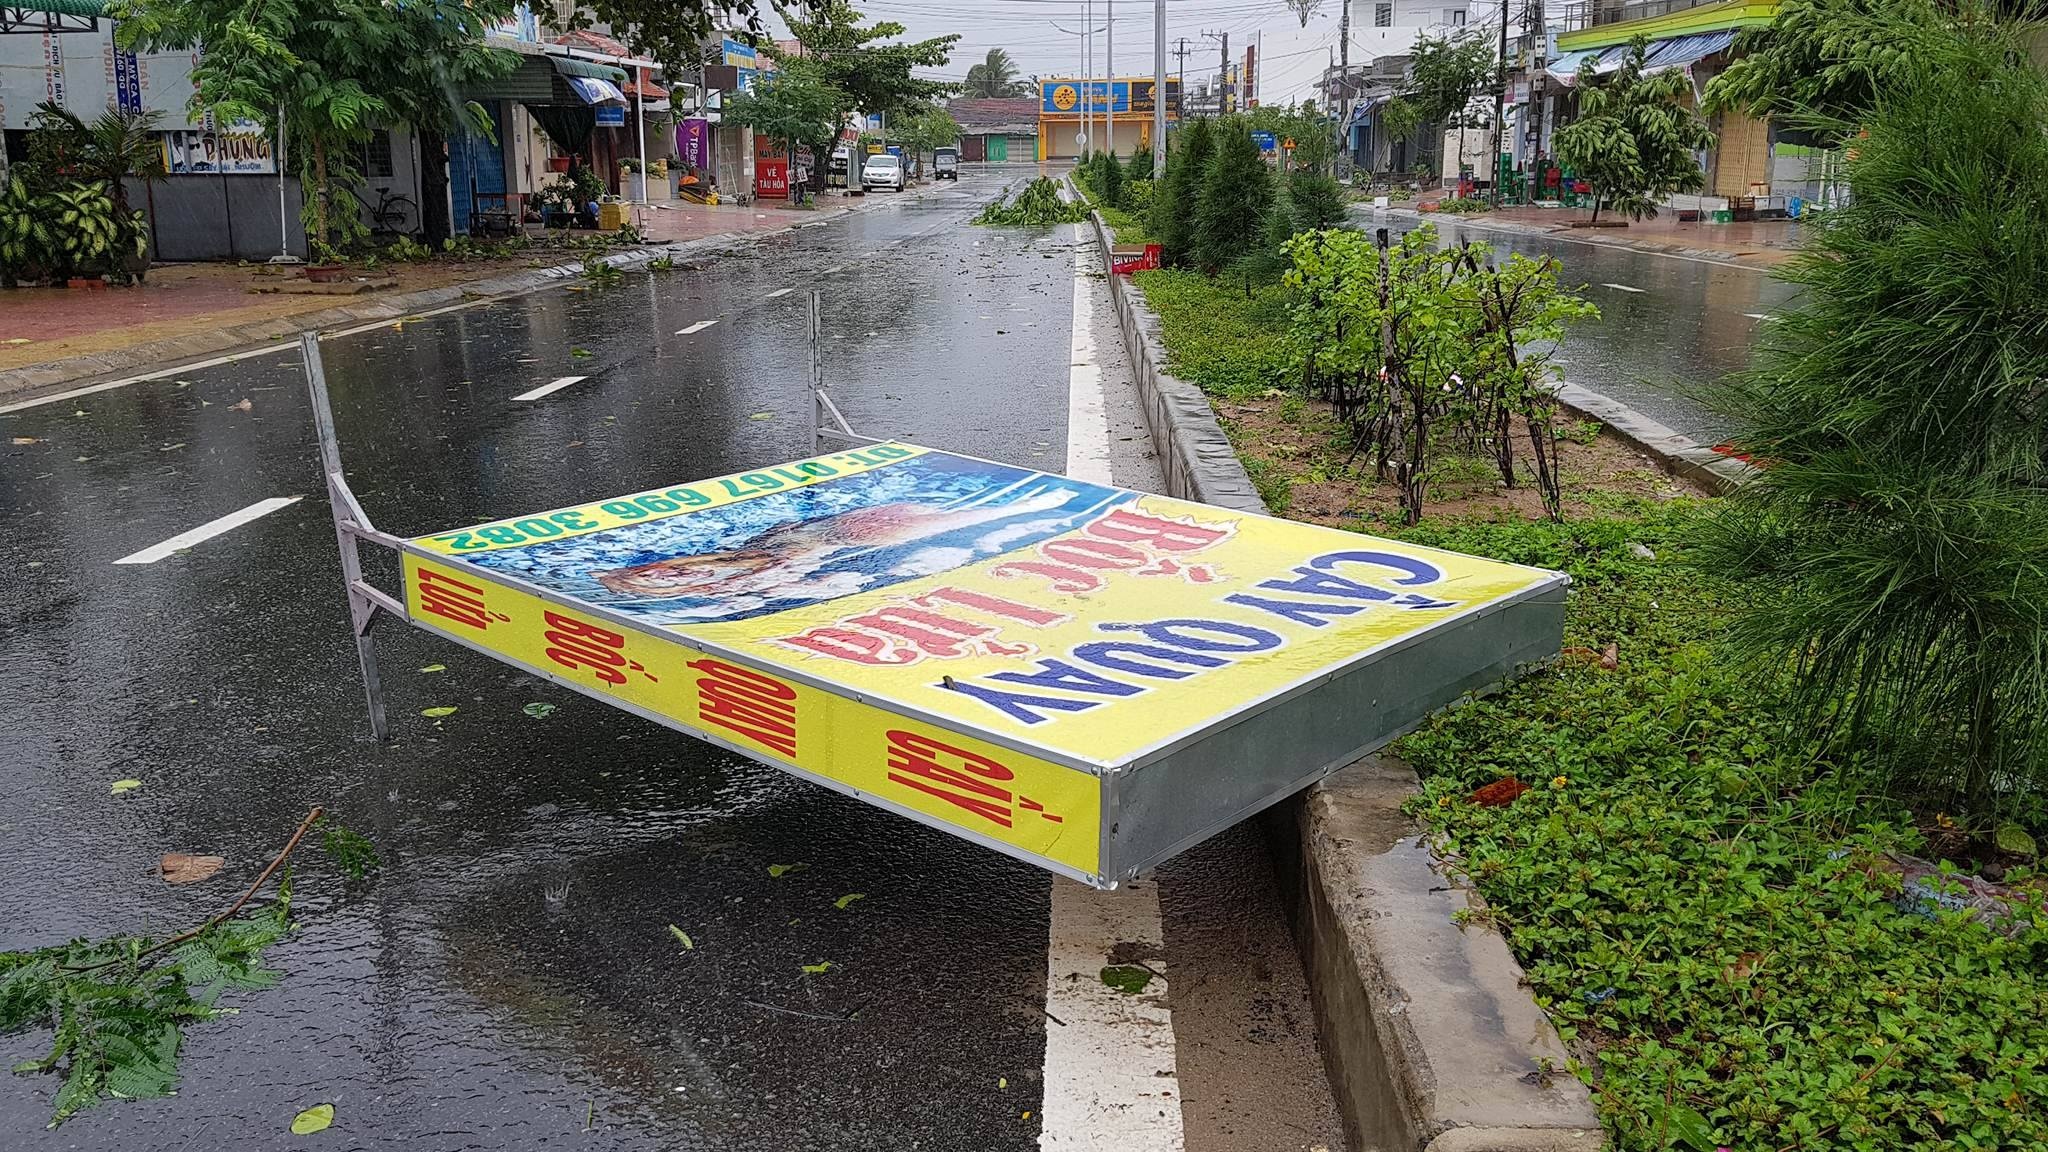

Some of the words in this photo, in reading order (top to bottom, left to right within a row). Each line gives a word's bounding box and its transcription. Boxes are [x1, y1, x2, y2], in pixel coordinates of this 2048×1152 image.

[690, 137, 699, 168] TPBank
[602, 488, 711, 520] 696
[718, 463, 838, 498] 0167
[437, 511, 599, 550] 3082
[418, 568, 511, 630] LỬA
[543, 610, 659, 684] BỐC
[938, 621, 1282, 725] QUAY
[687, 659, 796, 758] QUAY
